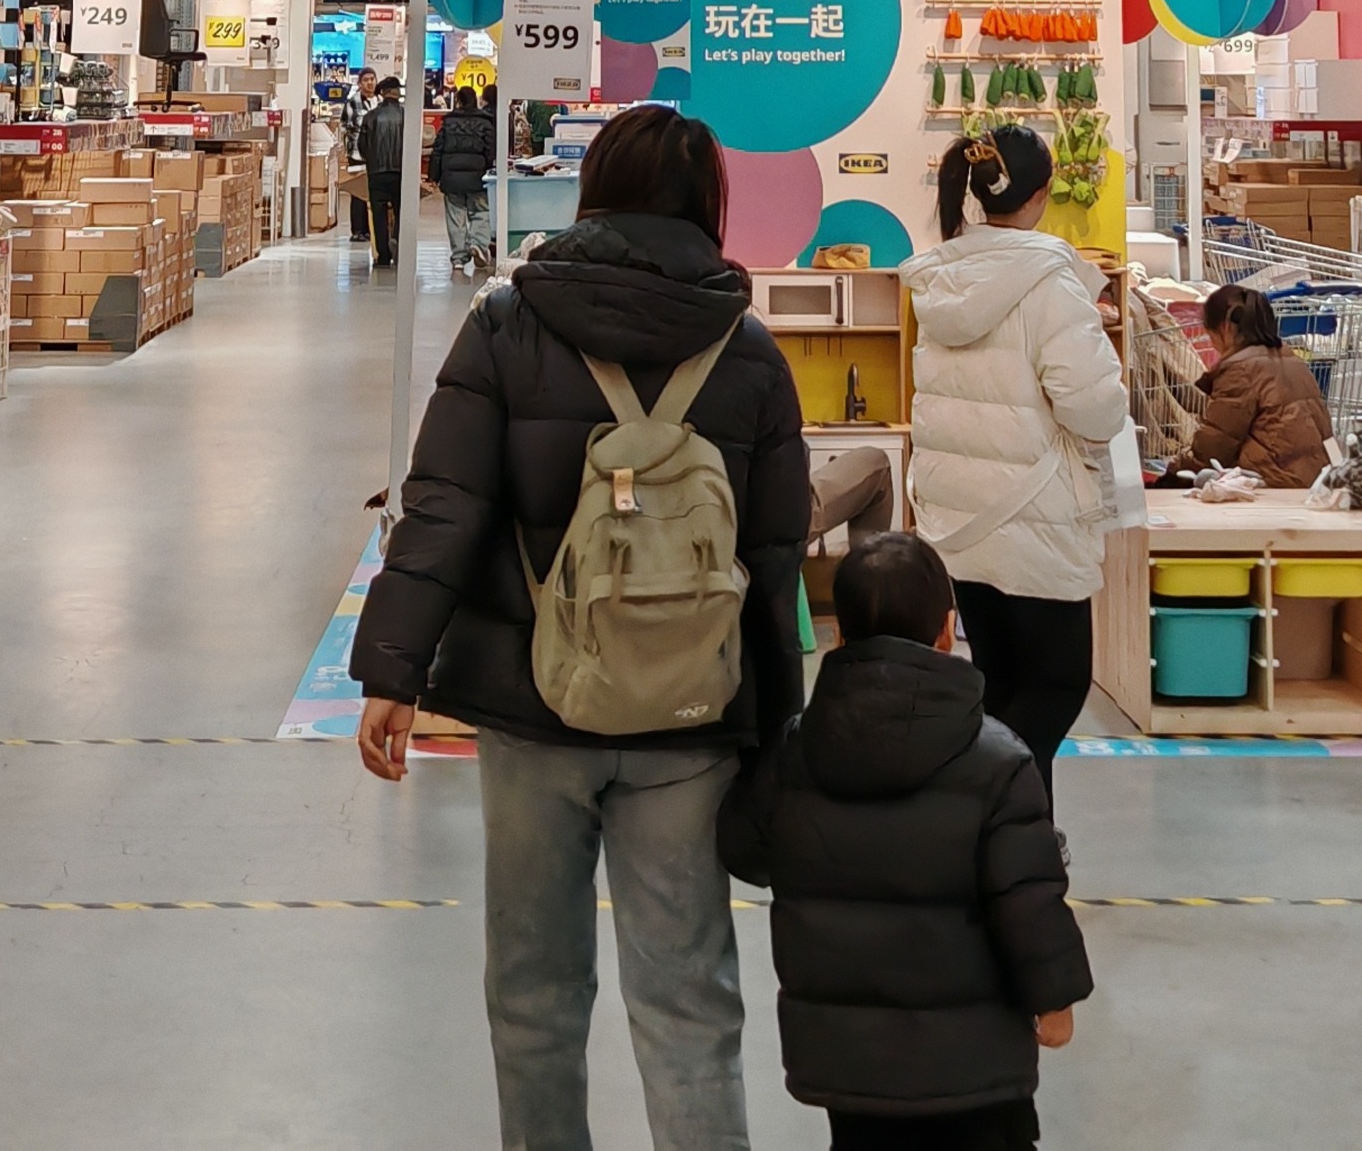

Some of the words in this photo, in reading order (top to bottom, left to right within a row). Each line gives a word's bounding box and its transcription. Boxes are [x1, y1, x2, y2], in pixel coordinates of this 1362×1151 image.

[80, 6, 128, 26] ¥249
[704, 3, 845, 40] 玩在一起
[208, 22, 243, 39] ¥299
[514, 23, 580, 50] ¥599
[704, 48, 738, 63] Let's
[741, 48, 774, 66] play
[776, 48, 846, 66] together!
[843, 158, 884, 169] IKEA
